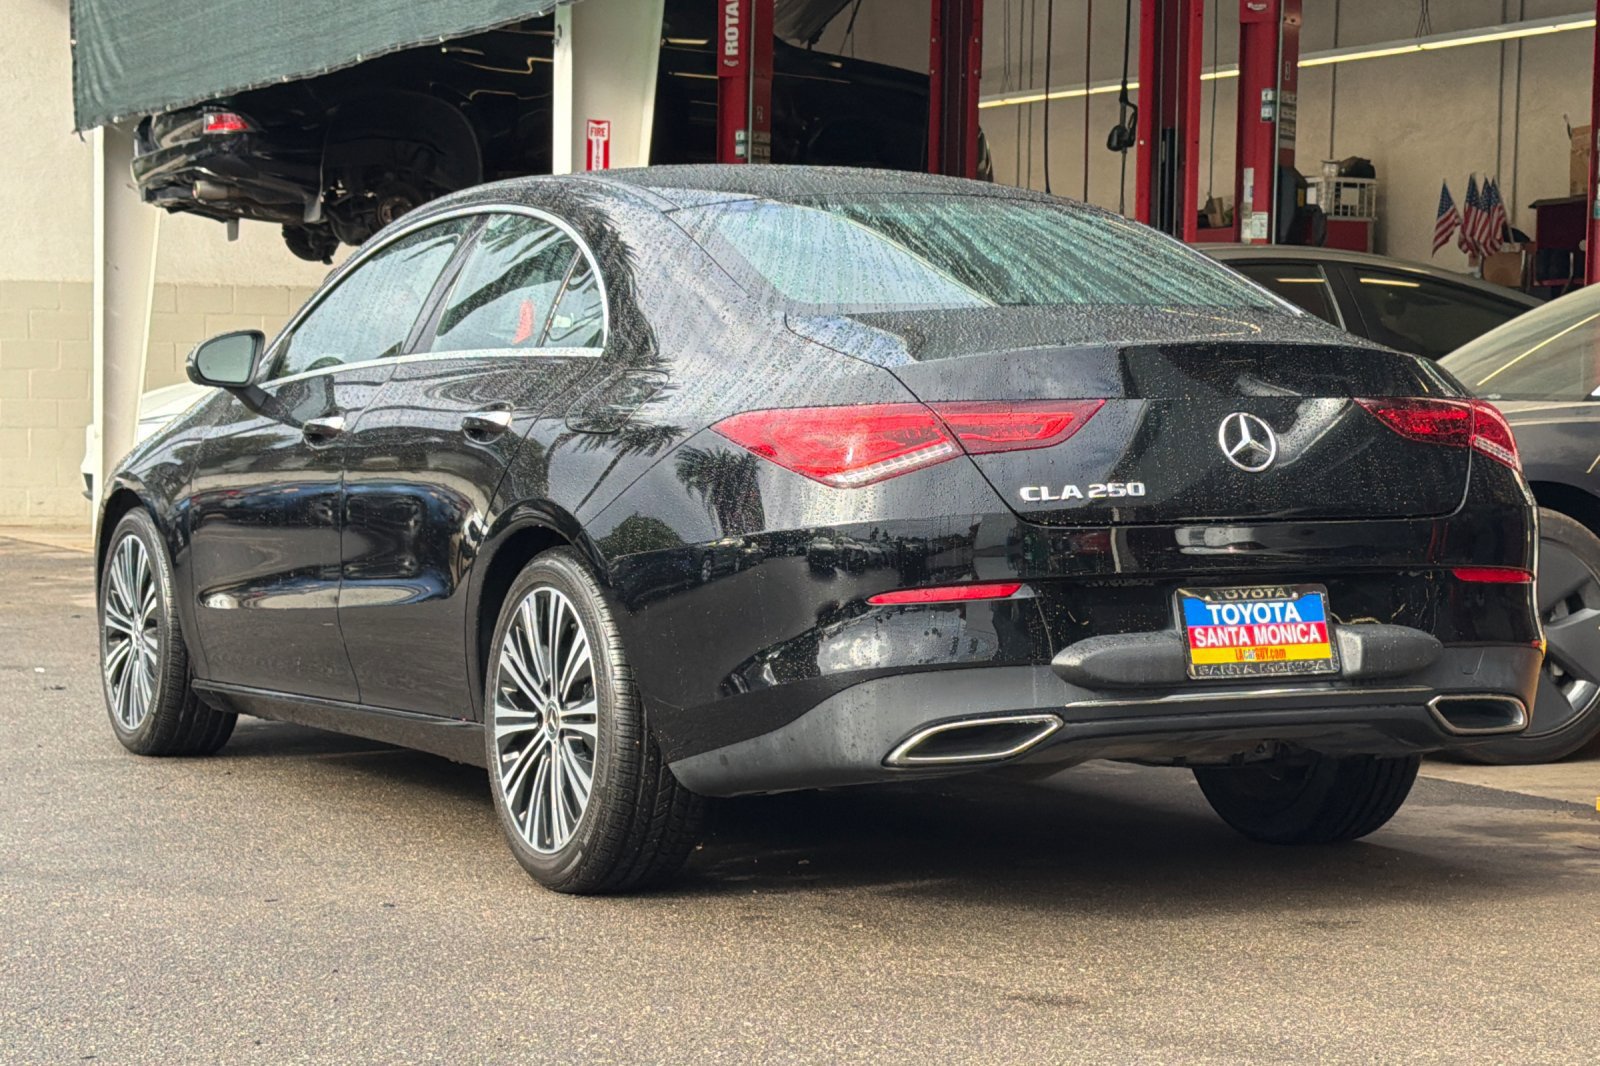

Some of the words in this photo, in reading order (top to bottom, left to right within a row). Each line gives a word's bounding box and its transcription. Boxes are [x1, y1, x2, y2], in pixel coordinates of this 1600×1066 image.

[725, 0, 740, 55] ROTA
[591, 127, 606, 137] FIRE
[1019, 484, 1084, 501] CLA
[1088, 482, 1146, 498] 250
[1214, 587, 1288, 600] TOYOTA
[1206, 602, 1303, 625] TOYOTA
[1194, 626, 1251, 648] SANTA
[1253, 623, 1322, 646] MONICA
